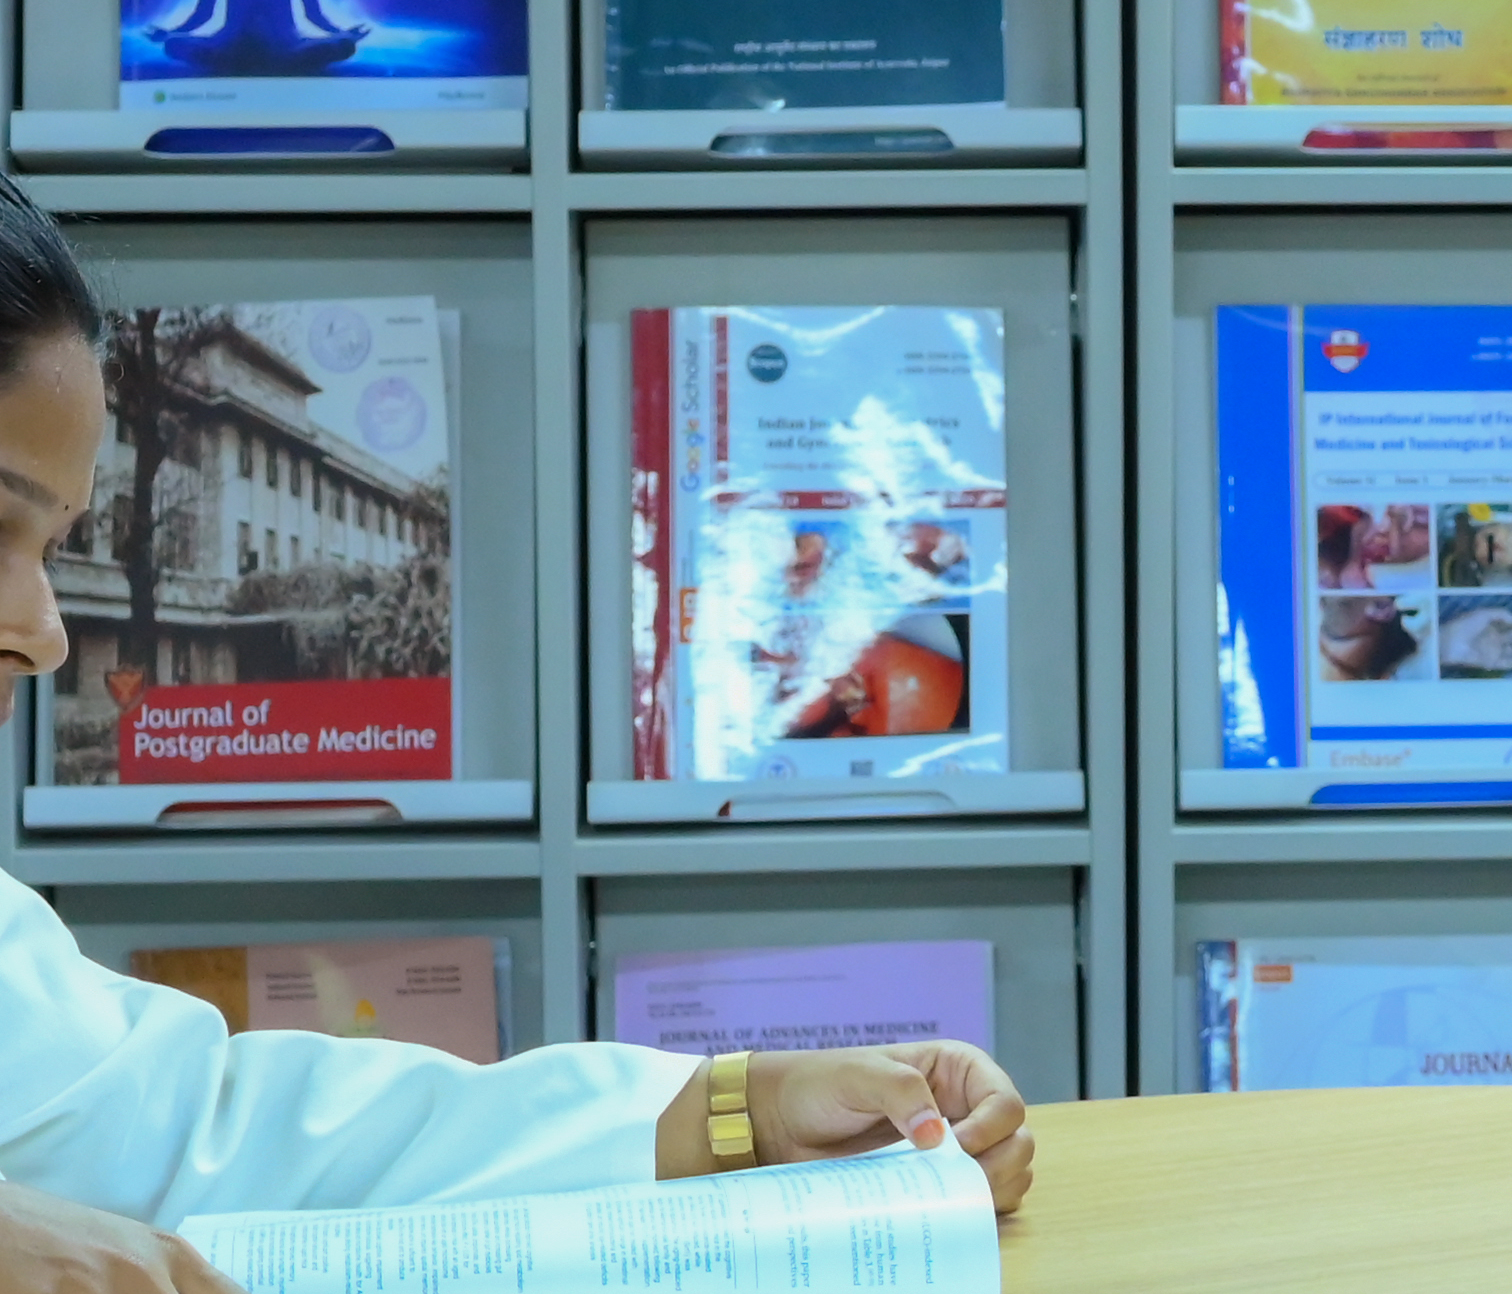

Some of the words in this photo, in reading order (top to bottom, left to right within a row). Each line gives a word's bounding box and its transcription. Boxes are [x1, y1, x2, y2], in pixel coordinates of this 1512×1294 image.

[134, 700, 232, 730] Journal
[242, 699, 272, 724] of
[134, 730, 309, 764] Postgraduate
[317, 724, 437, 753] Medicine
[660, 1028, 727, 1046] JOURNAL
[734, 1027, 753, 1043] OF
[760, 1025, 838, 1042] ADVANCES
[842, 1024, 858, 1037] IN
[864, 1020, 938, 1036] MEDICINE
